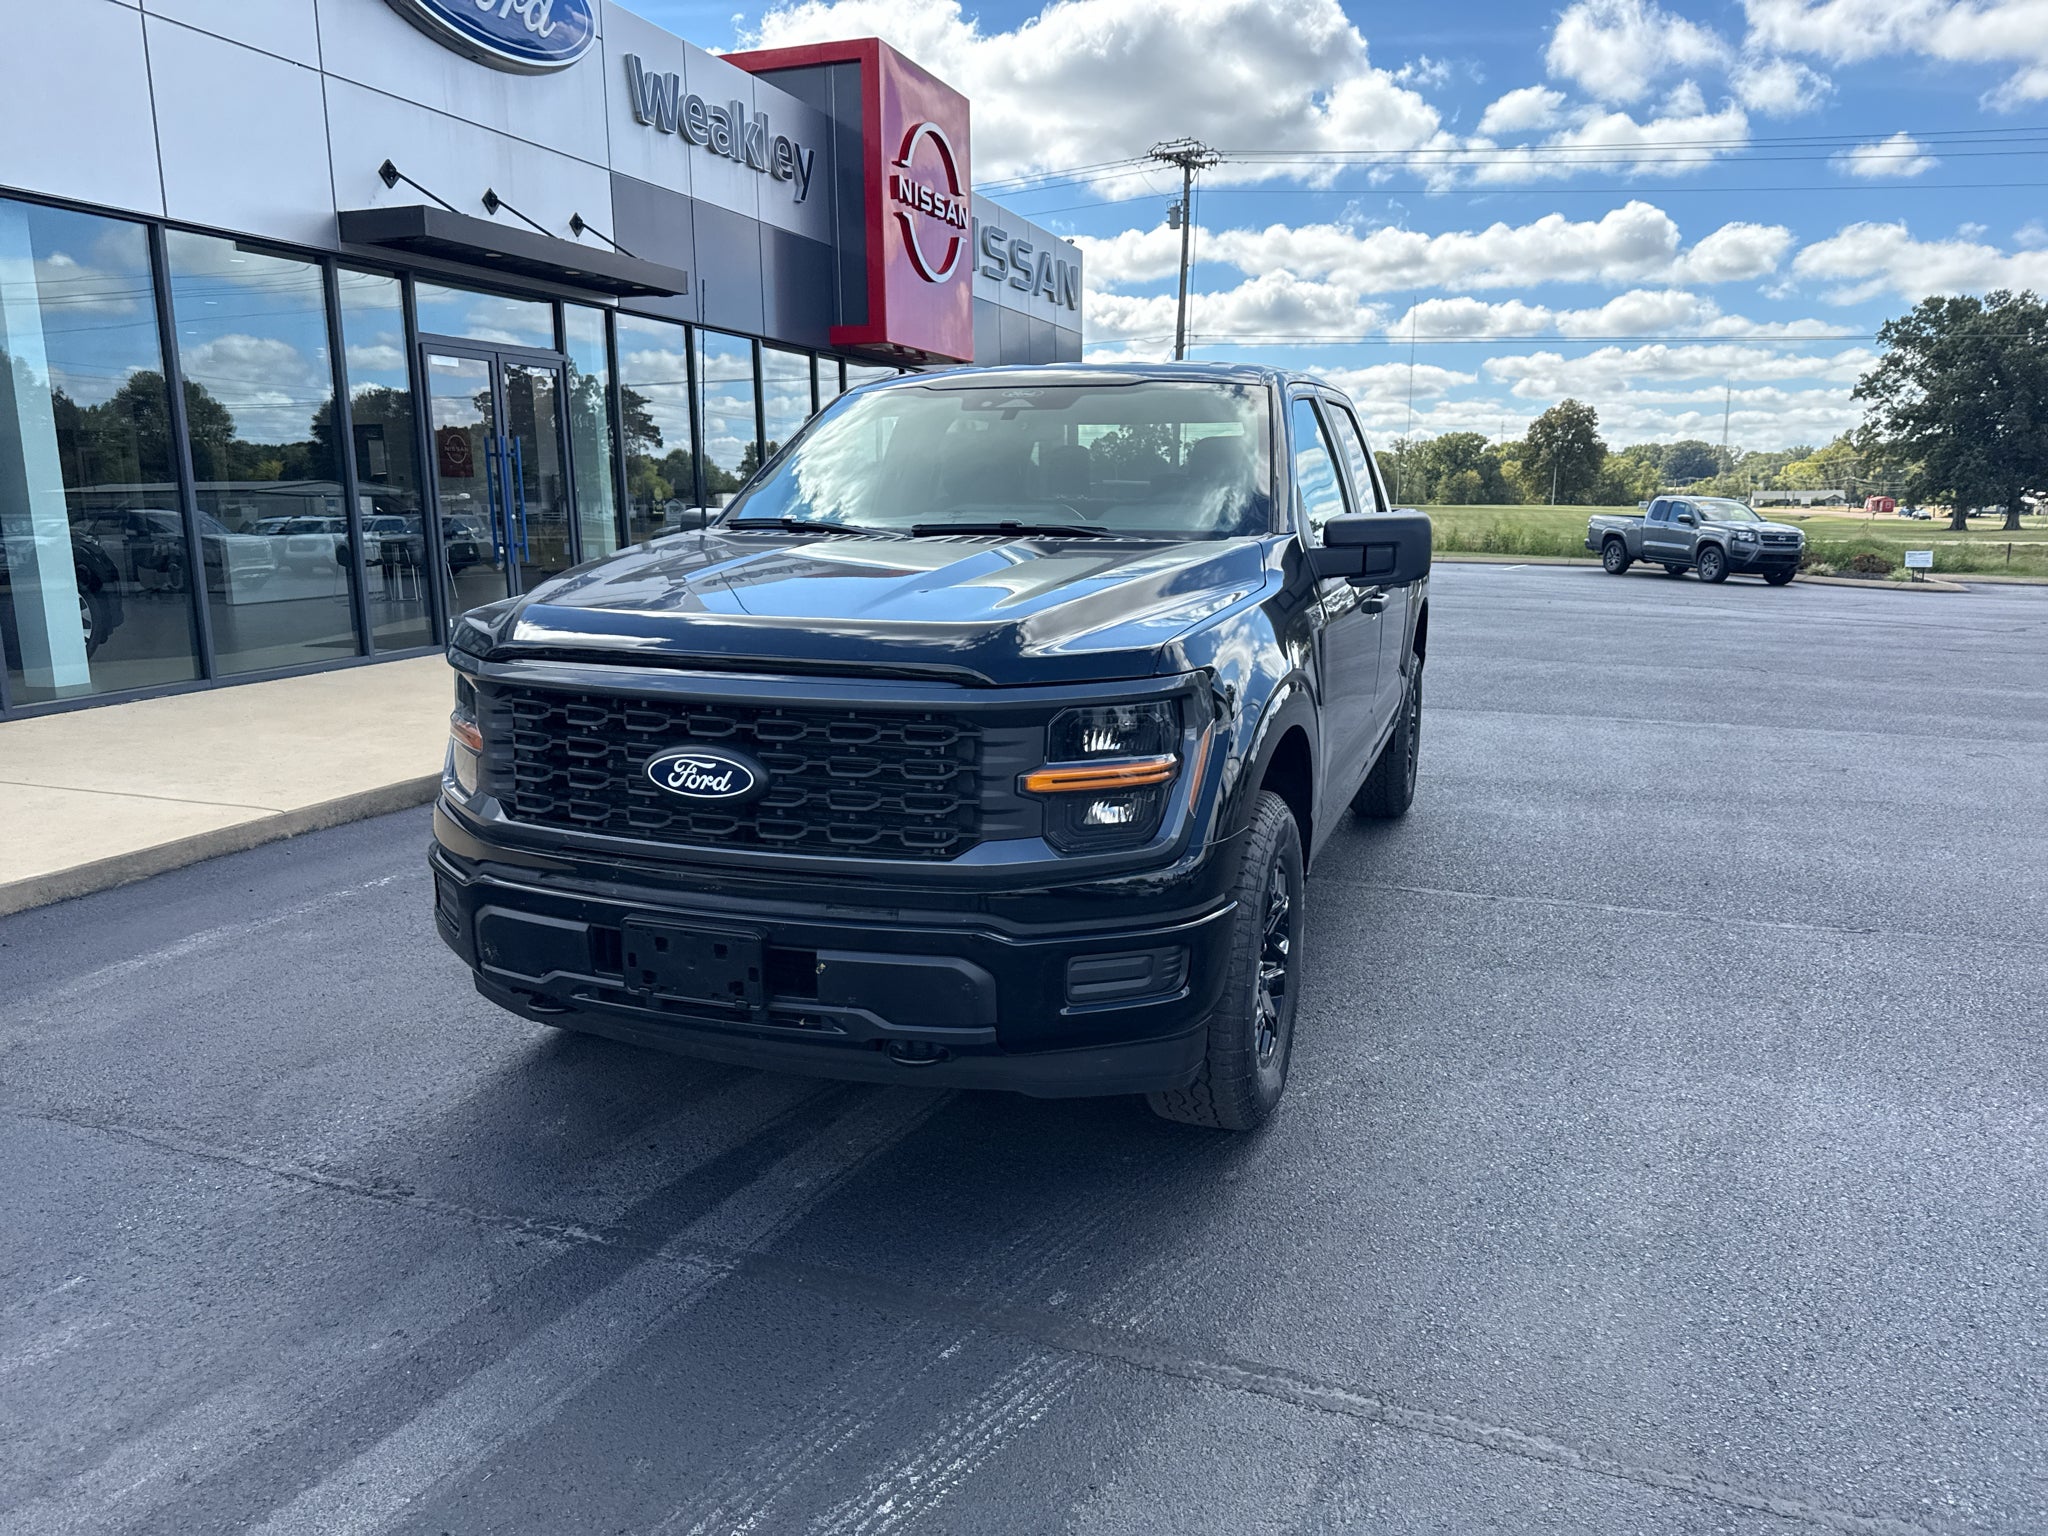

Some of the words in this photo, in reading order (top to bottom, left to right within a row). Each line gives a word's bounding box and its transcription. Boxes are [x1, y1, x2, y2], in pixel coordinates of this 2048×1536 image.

[475, 0, 556, 37] rd
[625, 53, 815, 202] Weakley
[892, 174, 969, 230] NISSAN
[972, 216, 1079, 310] ISSAN
[667, 759, 733, 792] Ford
